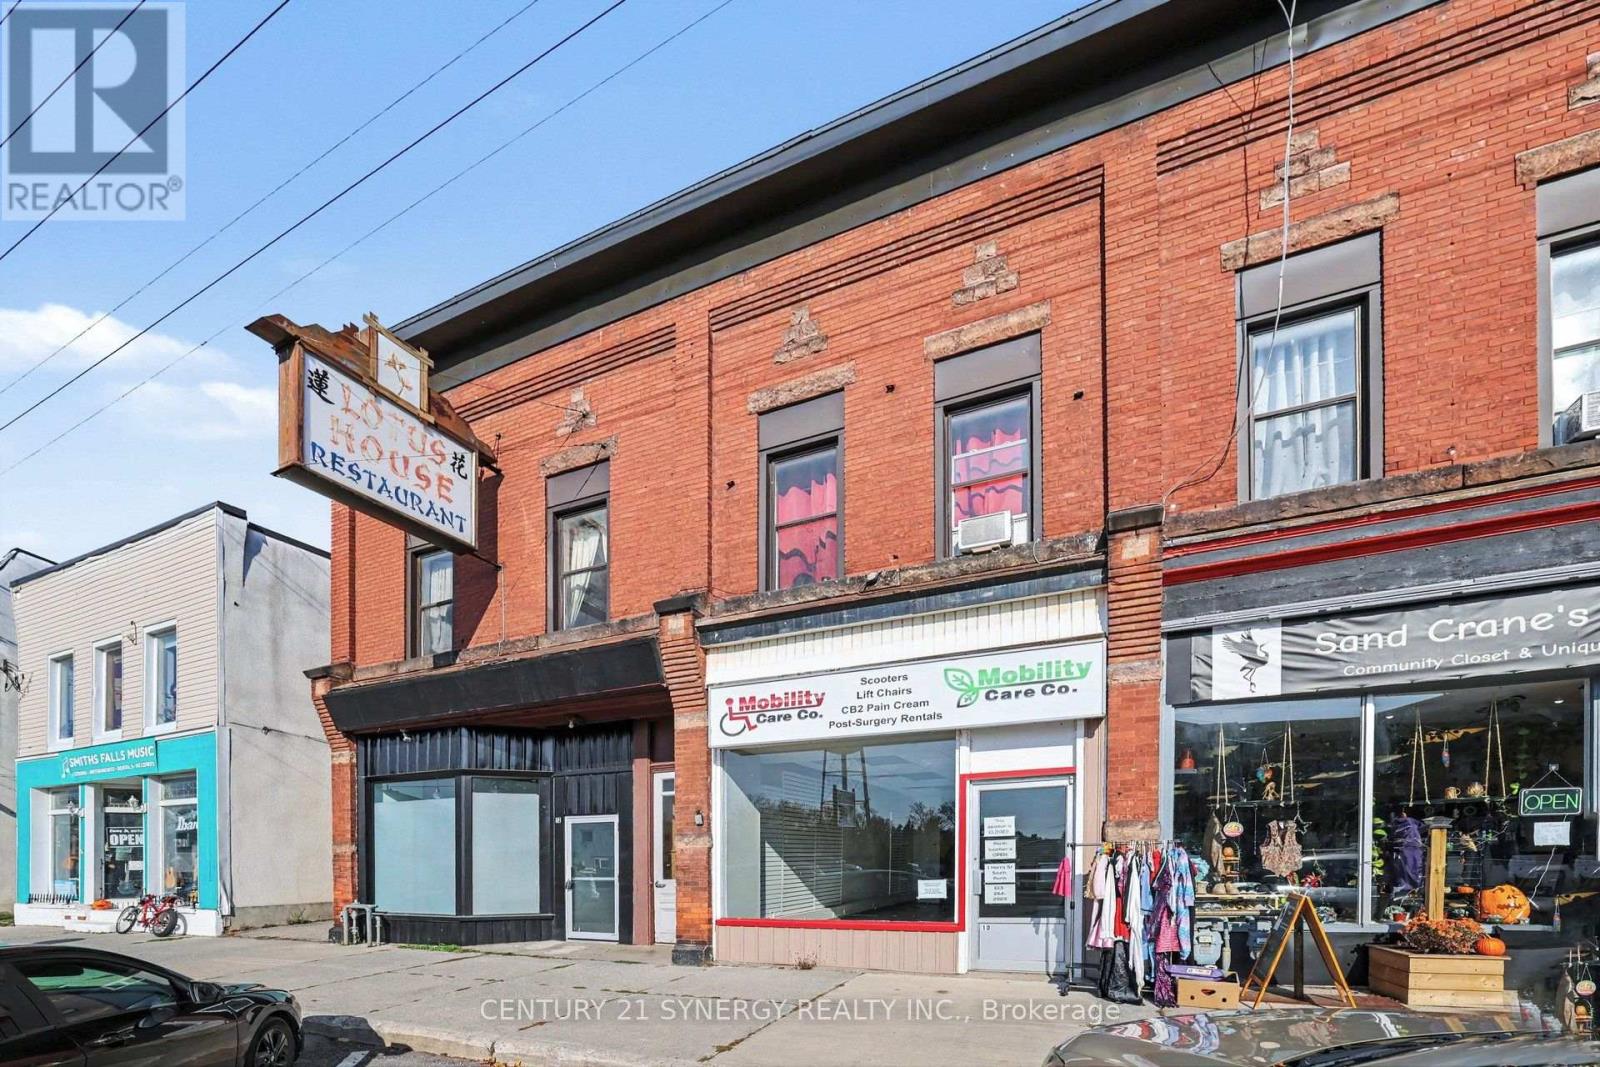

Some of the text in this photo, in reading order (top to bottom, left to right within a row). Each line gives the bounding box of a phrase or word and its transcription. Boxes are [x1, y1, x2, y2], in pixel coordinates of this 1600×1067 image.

[306, 368, 335, 405] 蓮
[341, 383, 447, 466] LOTUS
[330, 415, 455, 503] HOUSE
[450, 451, 468, 480] 花
[310, 441, 467, 533] RESTAURANT
[1314, 604, 1589, 655] Sand Crane's
[977, 659, 1094, 687] Mobility
[1343, 656, 1443, 677] Community
[1451, 649, 1511, 665] Closet
[1519, 647, 1533, 659] &
[860, 673, 909, 686] Scooters
[738, 690, 826, 712] Mobility
[856, 686, 913, 700] Lift Chairs
[984, 682, 1078, 702] Care Co.
[756, 708, 824, 724] Care Co.
[841, 699, 930, 716] CB2 Pain Cream
[828, 710, 943, 730] Post-Surgery Rentals
[69, 746, 155, 768] SMITHS FALLS MUSIC
[1524, 793, 1579, 810] OPEN
[109, 834, 144, 845] OPEN
